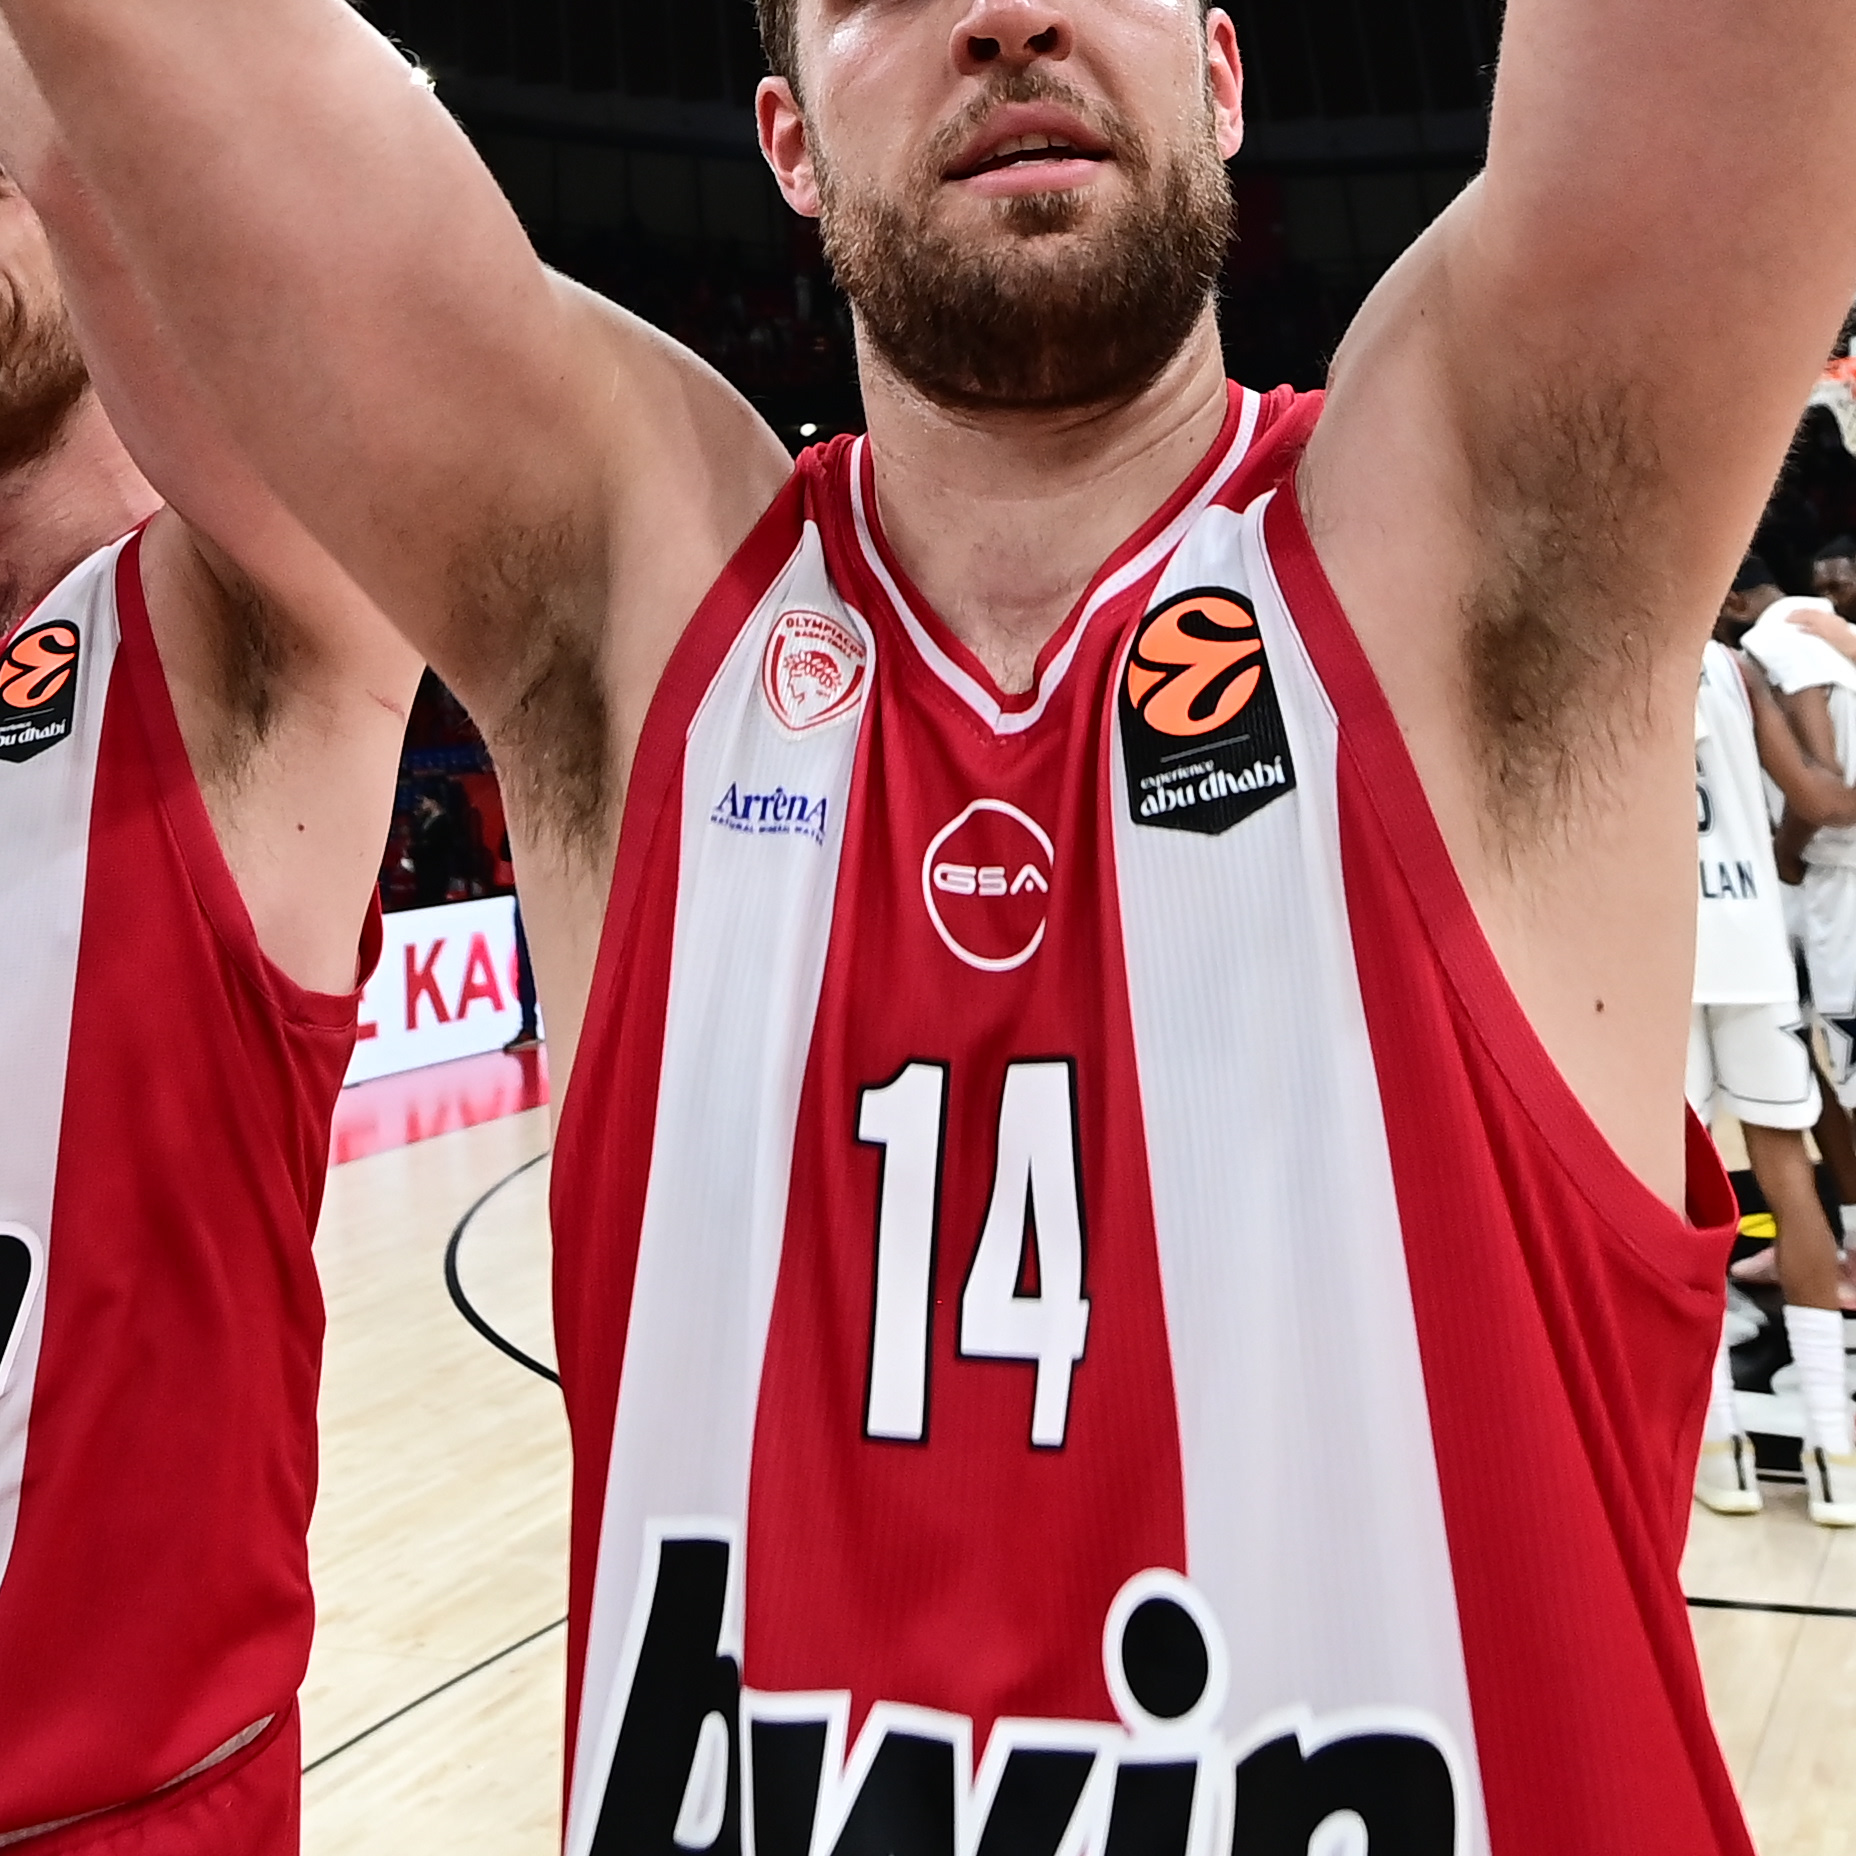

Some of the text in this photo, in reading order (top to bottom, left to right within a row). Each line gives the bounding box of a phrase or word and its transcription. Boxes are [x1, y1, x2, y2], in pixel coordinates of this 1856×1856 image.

[1140, 755, 1285, 816] abu dhabi
[933, 862, 1049, 896] GSA
[1699, 860, 1758, 899] LAN
[855, 1058, 1090, 1448] 14
